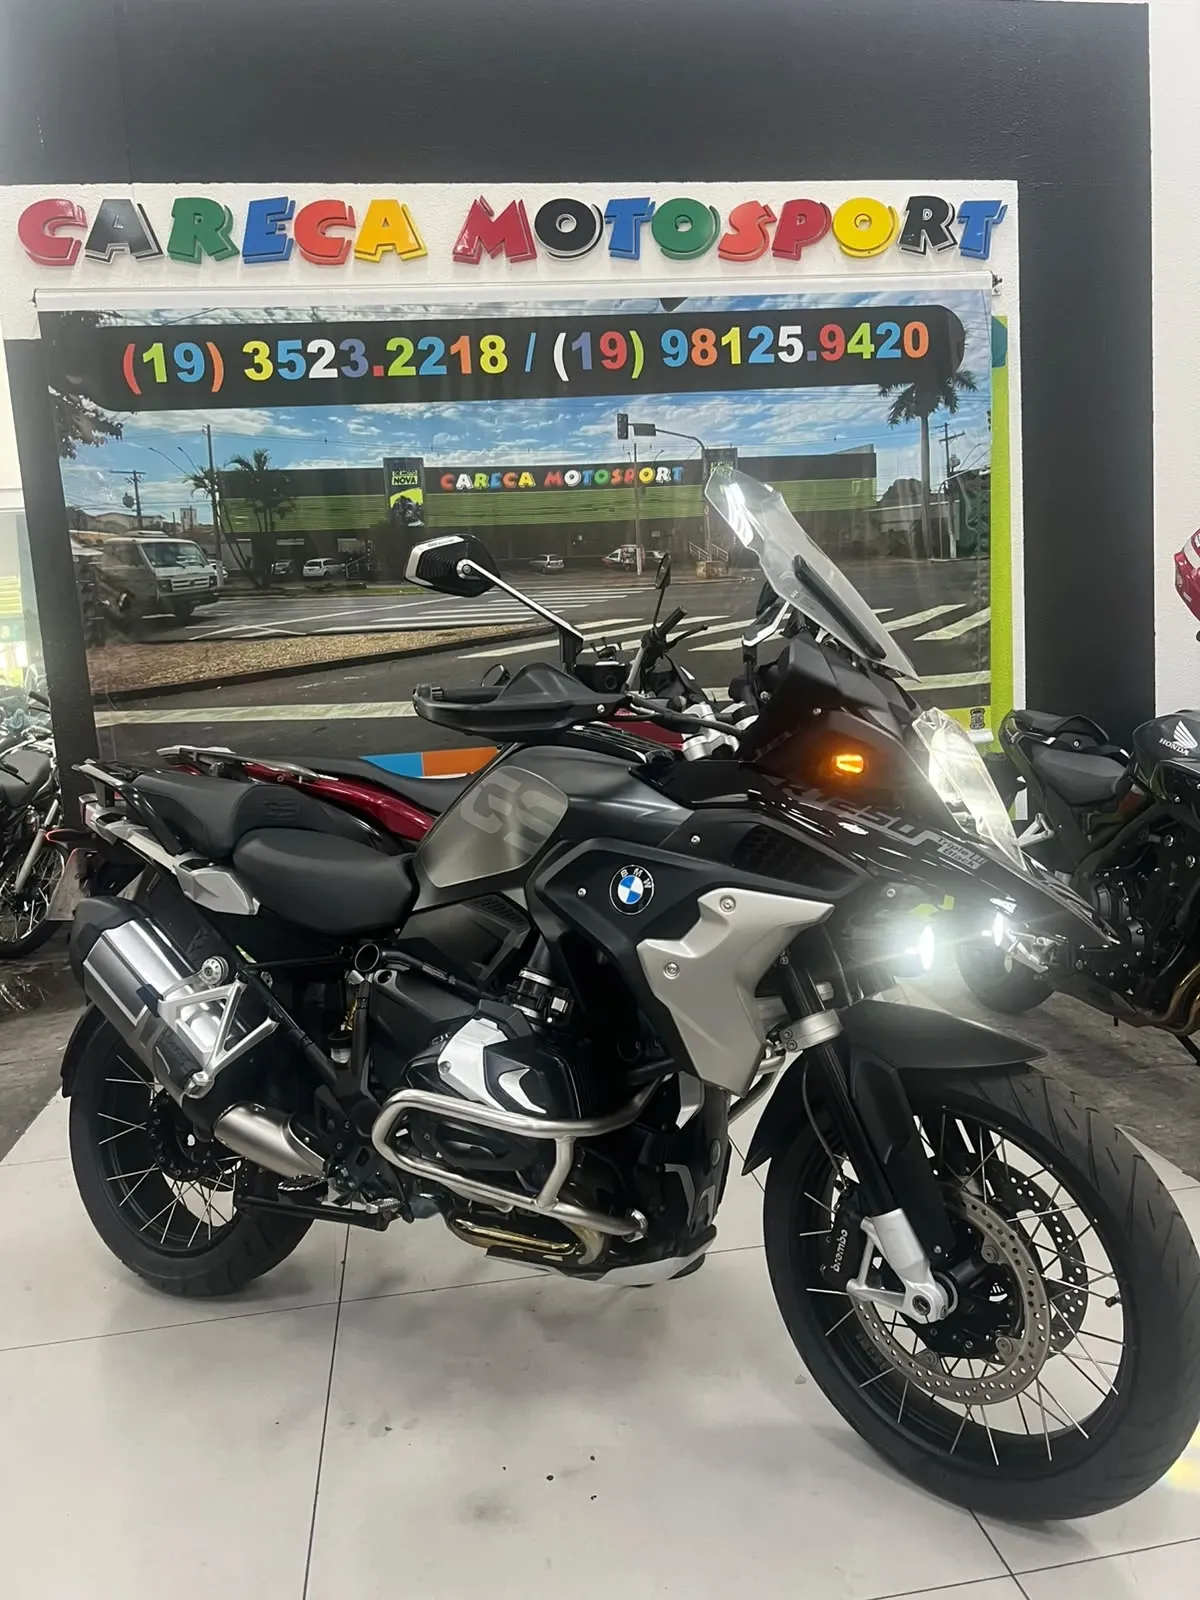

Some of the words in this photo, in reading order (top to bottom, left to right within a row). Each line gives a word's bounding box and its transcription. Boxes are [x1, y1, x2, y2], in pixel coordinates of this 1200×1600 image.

[17, 196, 428, 266] CARECA
[452, 193, 1007, 264] MOTOSPORT
[122, 341, 225, 395] (19)
[242, 334, 508, 381] 3523.2218
[553, 329, 645, 382] (19)
[661, 321, 929, 368] 98125.9420
[393, 476, 416, 484] NOVA
[440, 472, 536, 491] CARECA
[544, 466, 683, 487] MOTOSPORT
[1159, 738, 1189, 756] HONDA
[620, 868, 652, 888] BMW
[830, 1229, 849, 1272] brembo
